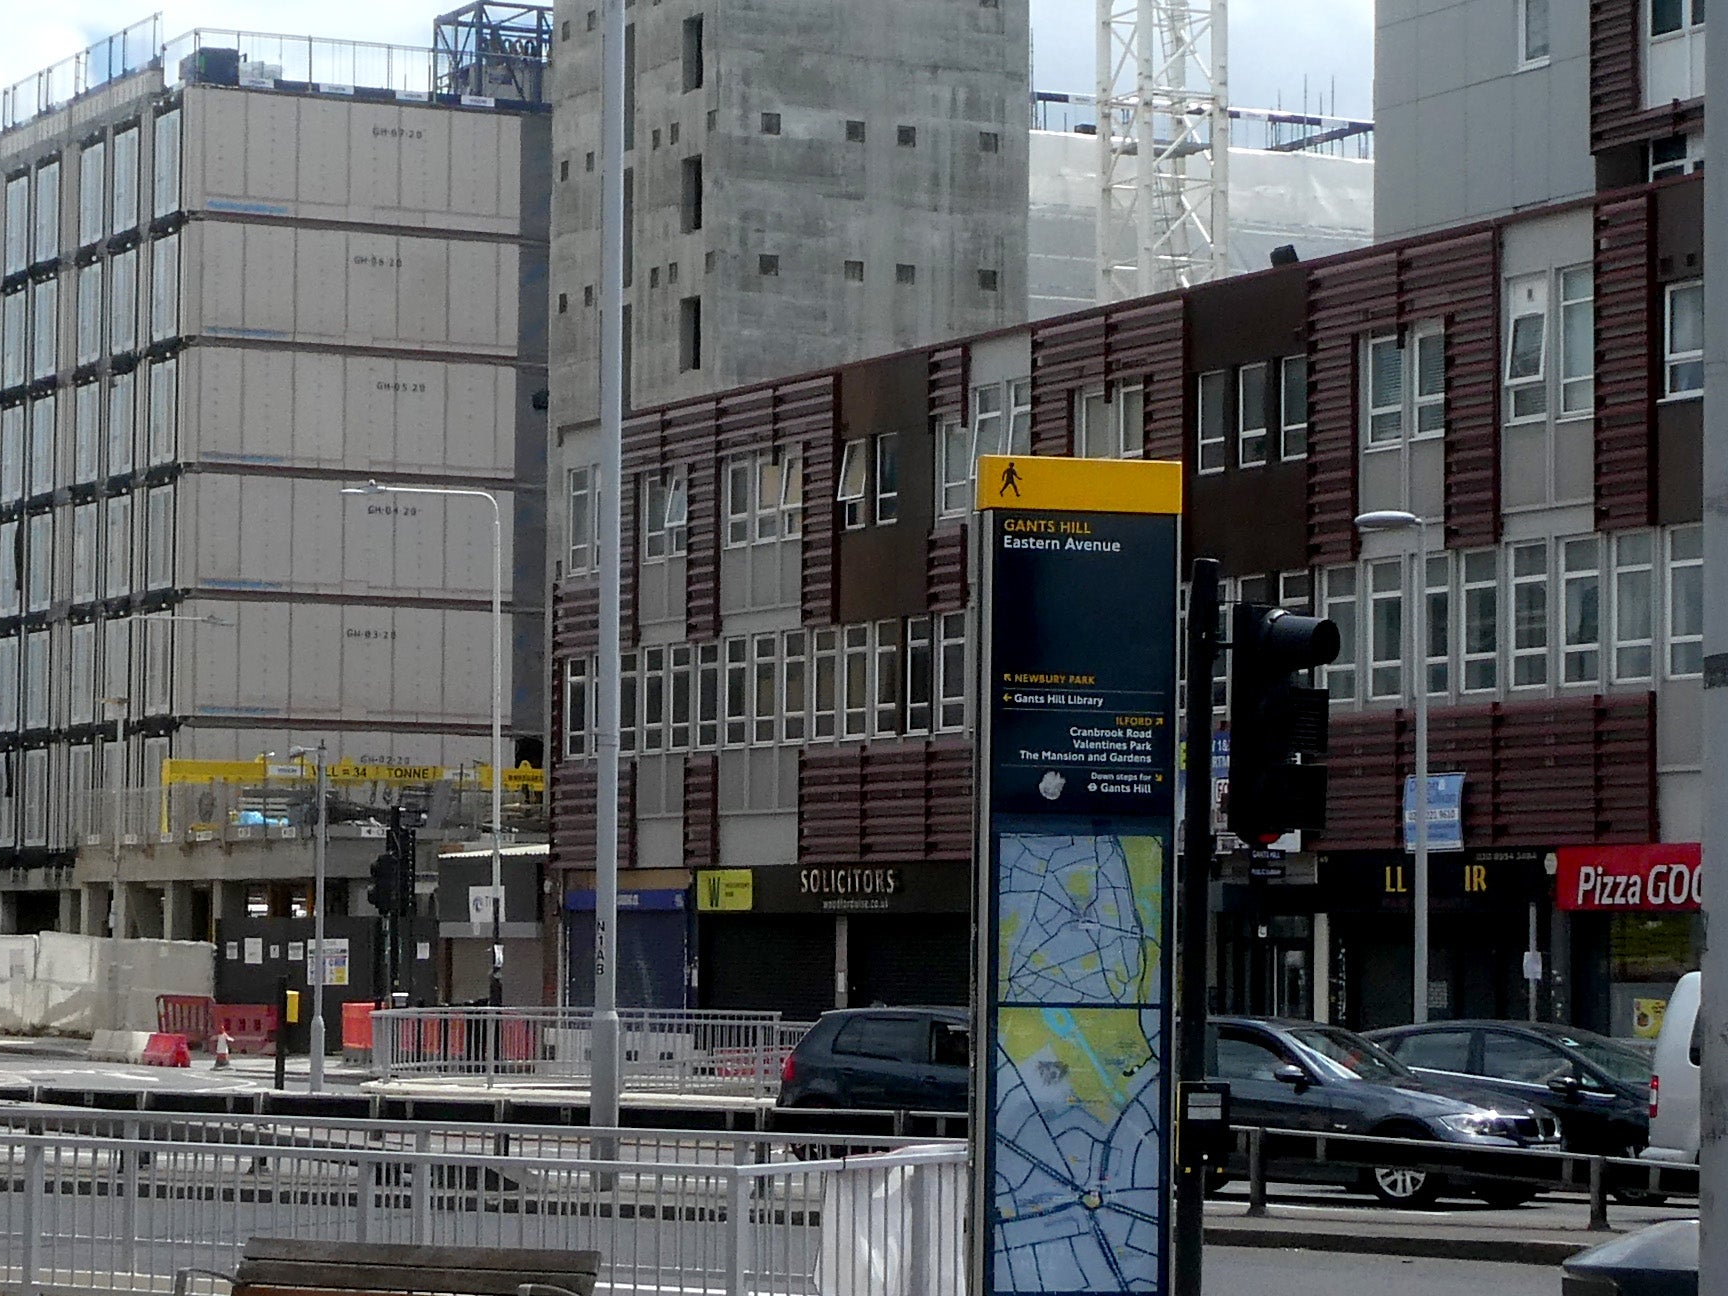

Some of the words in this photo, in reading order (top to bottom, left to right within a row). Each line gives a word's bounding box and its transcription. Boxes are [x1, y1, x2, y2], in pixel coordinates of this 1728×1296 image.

[1004, 518, 1055, 533] GANTS
[1060, 520, 1091, 534] HILL
[1004, 535, 1060, 550] Eastern
[1065, 537, 1121, 552] Avenue
[1014, 673, 1066, 685] NEWBURY
[1069, 675, 1095, 685] PARK
[1014, 694, 1044, 705] Gants
[1047, 694, 1066, 705] Hill
[1068, 695, 1103, 707] Library
[1116, 716, 1152, 726] ILFORD
[1070, 727, 1123, 738] Cranbrook
[1126, 728, 1152, 738] Road
[1073, 739, 1127, 750] Valentines
[1130, 740, 1152, 751] Park
[1020, 750, 1038, 760] The
[1042, 751, 1086, 762] Mansion
[1088, 751, 1107, 762] and
[1109, 752, 1152, 763] Gardens
[354, 767, 367, 777] 34
[386, 767, 429, 779] TONNE
[1100, 783, 1128, 794] Gants
[1131, 783, 1152, 794] Hill
[800, 868, 895, 894] SOLICITORS
[1577, 865, 1642, 905] Pizza
